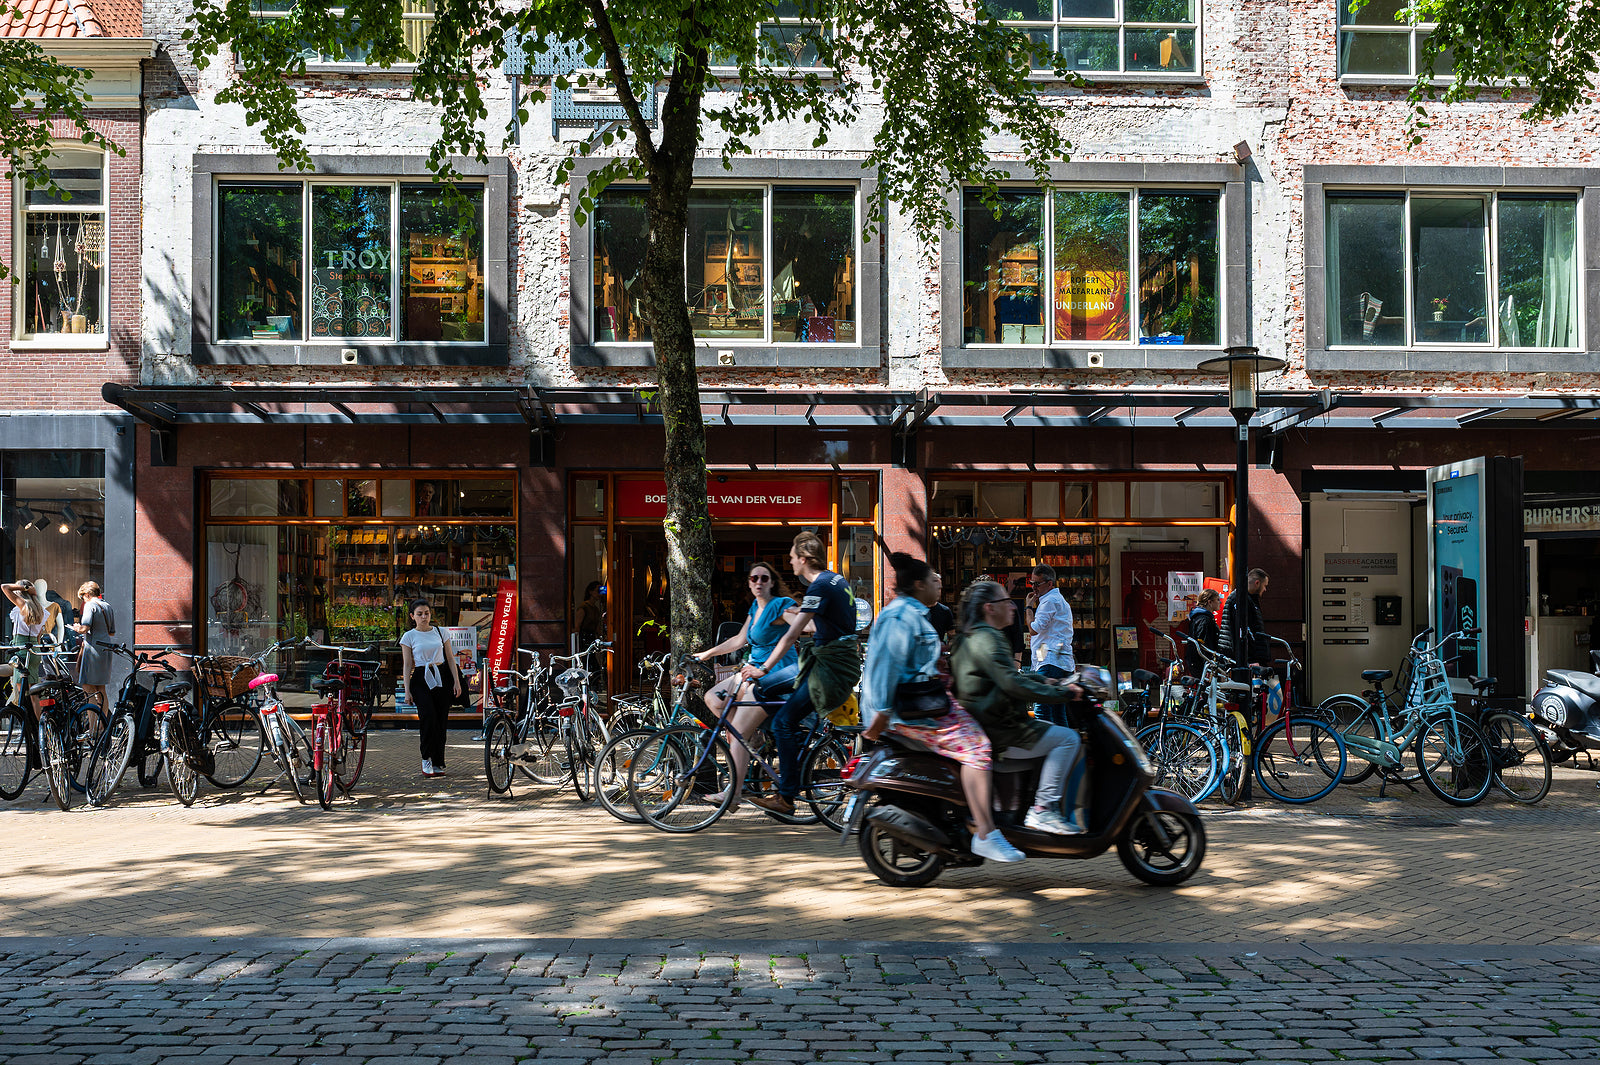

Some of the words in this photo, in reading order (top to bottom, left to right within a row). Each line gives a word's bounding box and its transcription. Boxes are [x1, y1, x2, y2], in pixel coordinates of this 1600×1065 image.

[323, 249, 391, 270] TROY
[329, 271, 366, 281] Stephen
[369, 271, 384, 281] Fry
[1056, 302, 1114, 310] UNDERLAND
[720, 495, 743, 504] VAN
[745, 495, 767, 504] DER
[769, 495, 802, 504] VELDE
[1453, 510, 1474, 522] privacy.
[1523, 505, 1591, 526] BURGERS
[502, 592, 514, 618] VELDE
[499, 619, 508, 636] DER
[496, 637, 505, 656] VAN
